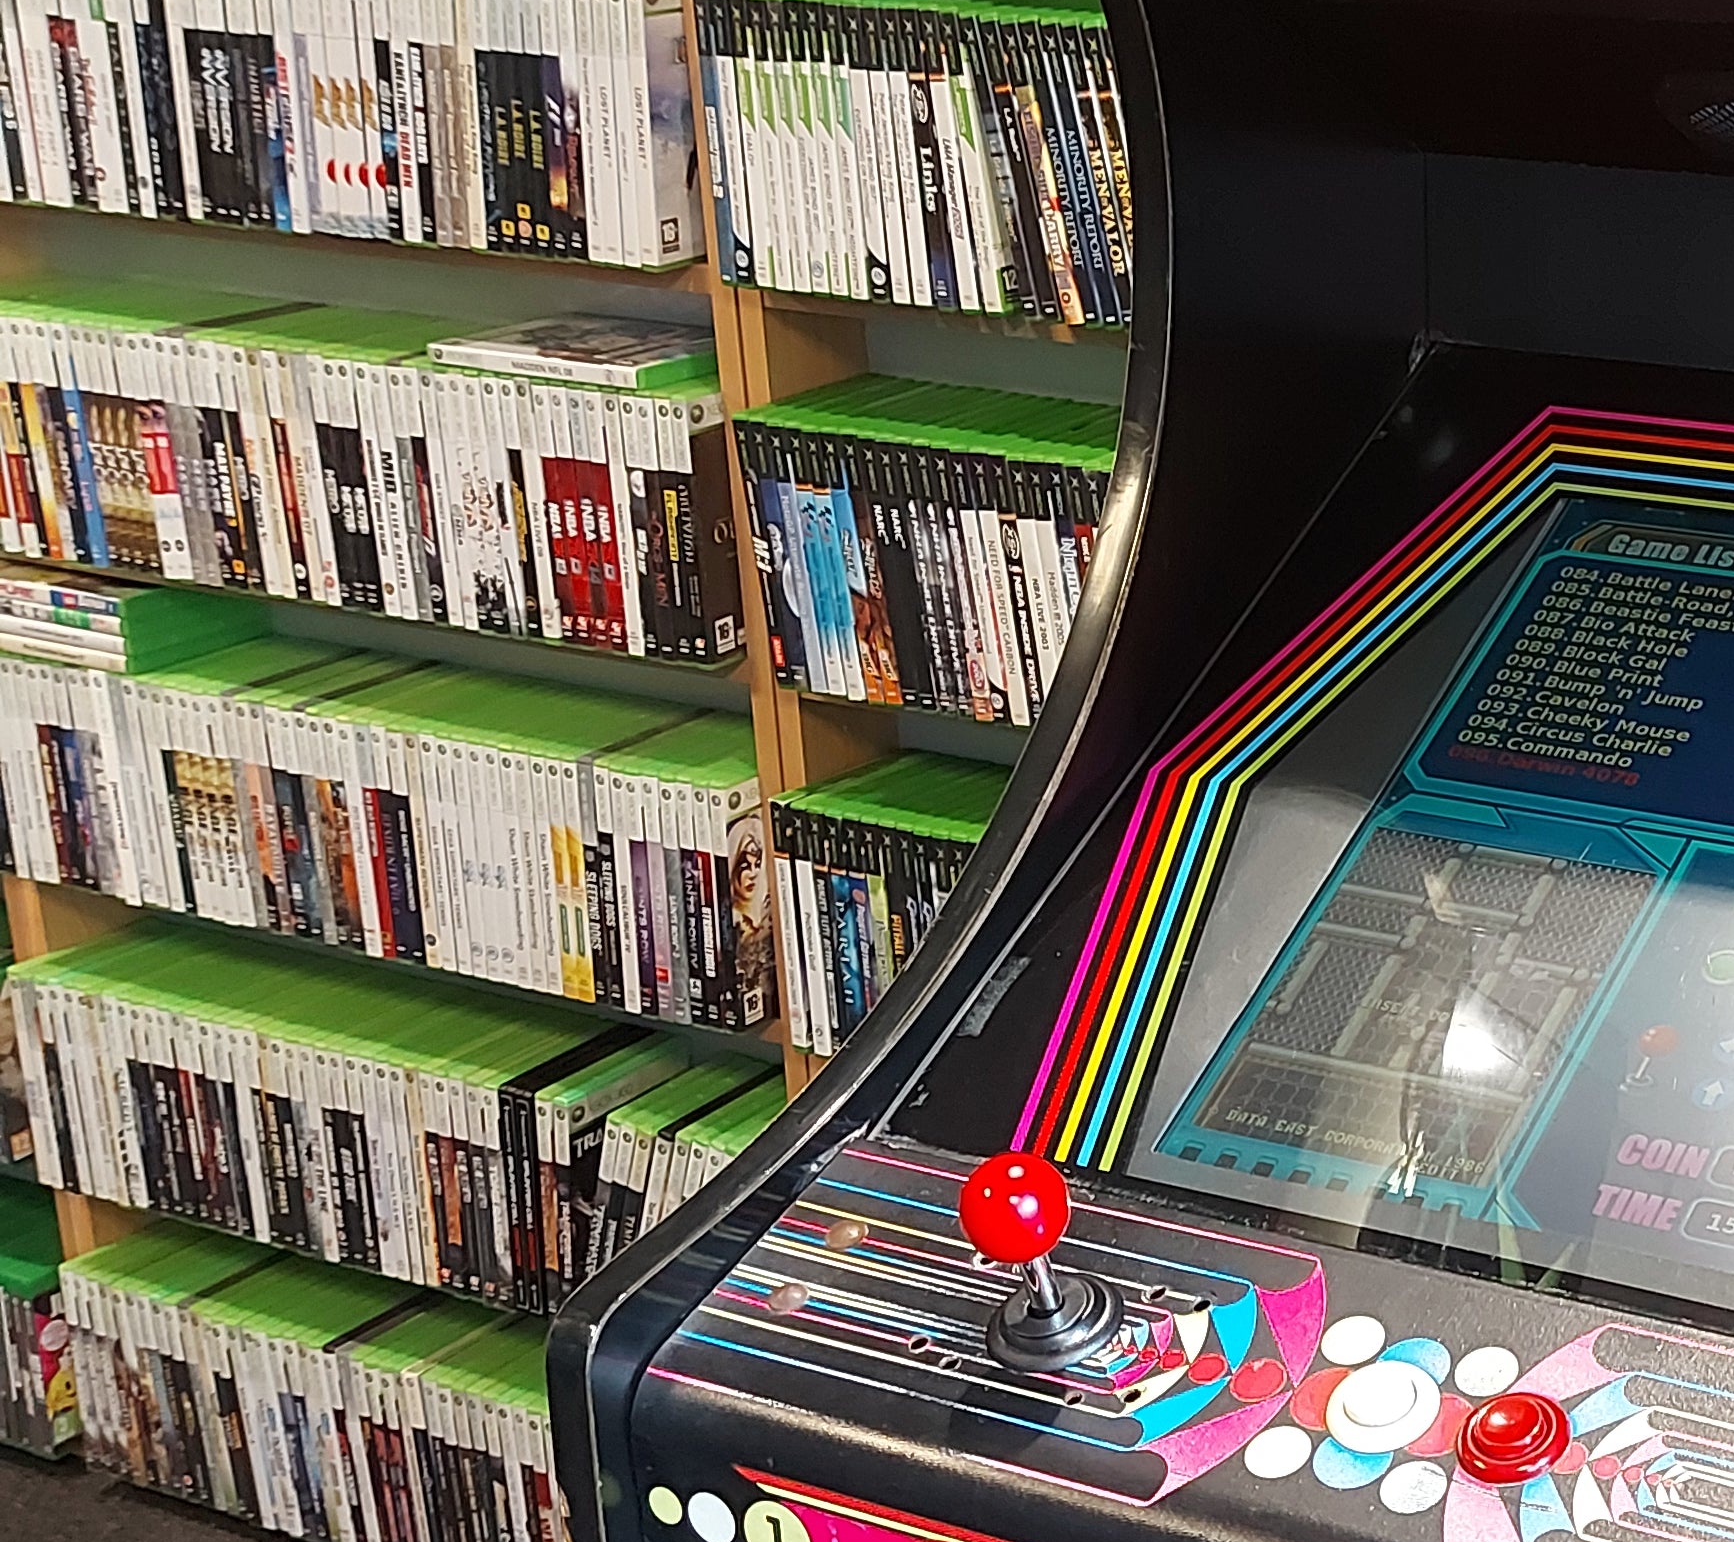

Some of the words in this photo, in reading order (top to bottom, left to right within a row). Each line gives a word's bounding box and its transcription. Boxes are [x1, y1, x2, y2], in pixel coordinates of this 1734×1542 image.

[634, 87, 643, 115] LOST
[636, 118, 646, 160] PLANET
[918, 146, 939, 216] Links
[1065, 130, 1094, 211] MINORITY
[1088, 149, 1111, 198] MEN
[1099, 207, 1125, 277] VALOR
[987, 539, 1001, 566] NEED
[1608, 533, 1691, 561] Game
[992, 569, 1004, 590] FOR
[1031, 578, 1041, 600] NBA
[1560, 566, 1672, 592] 084.Battle
[1035, 602, 1045, 624] LIVE
[1543, 595, 1671, 622] 086.Beastie
[1552, 580, 1733, 618] 085.Battle-Road,
[1524, 624, 1632, 650] 088.Black
[1637, 639, 1688, 658] Hole
[1533, 610, 1611, 631] 087.Bio
[1619, 621, 1696, 643] Attack
[1001, 631, 1016, 676] CARBON
[1506, 654, 1602, 679] 090.Blue
[1608, 668, 1664, 688] Print
[1515, 639, 1624, 665] 089.Block
[1629, 653, 1667, 671] Gal
[1486, 684, 1624, 716] 092.Cavelon
[1496, 669, 1605, 699] 091.Bump
[1616, 686, 1640, 701] 'n'
[1644, 693, 1703, 713] Jump
[1467, 714, 1584, 744] 094.Circus
[1593, 732, 1673, 757] Charlie
[1478, 699, 1610, 731] 093.Cheeky
[1615, 718, 1691, 742] Mouse
[1457, 730, 1632, 768] 095.Commando
[835, 901, 854, 1004] PARIAH
[1226, 1109, 1268, 1127] DATA
[1274, 1120, 1319, 1138] EAST
[1448, 1155, 1486, 1174] 1986
[1616, 1134, 1710, 1179] COIN
[1592, 1184, 1683, 1232] TIME
